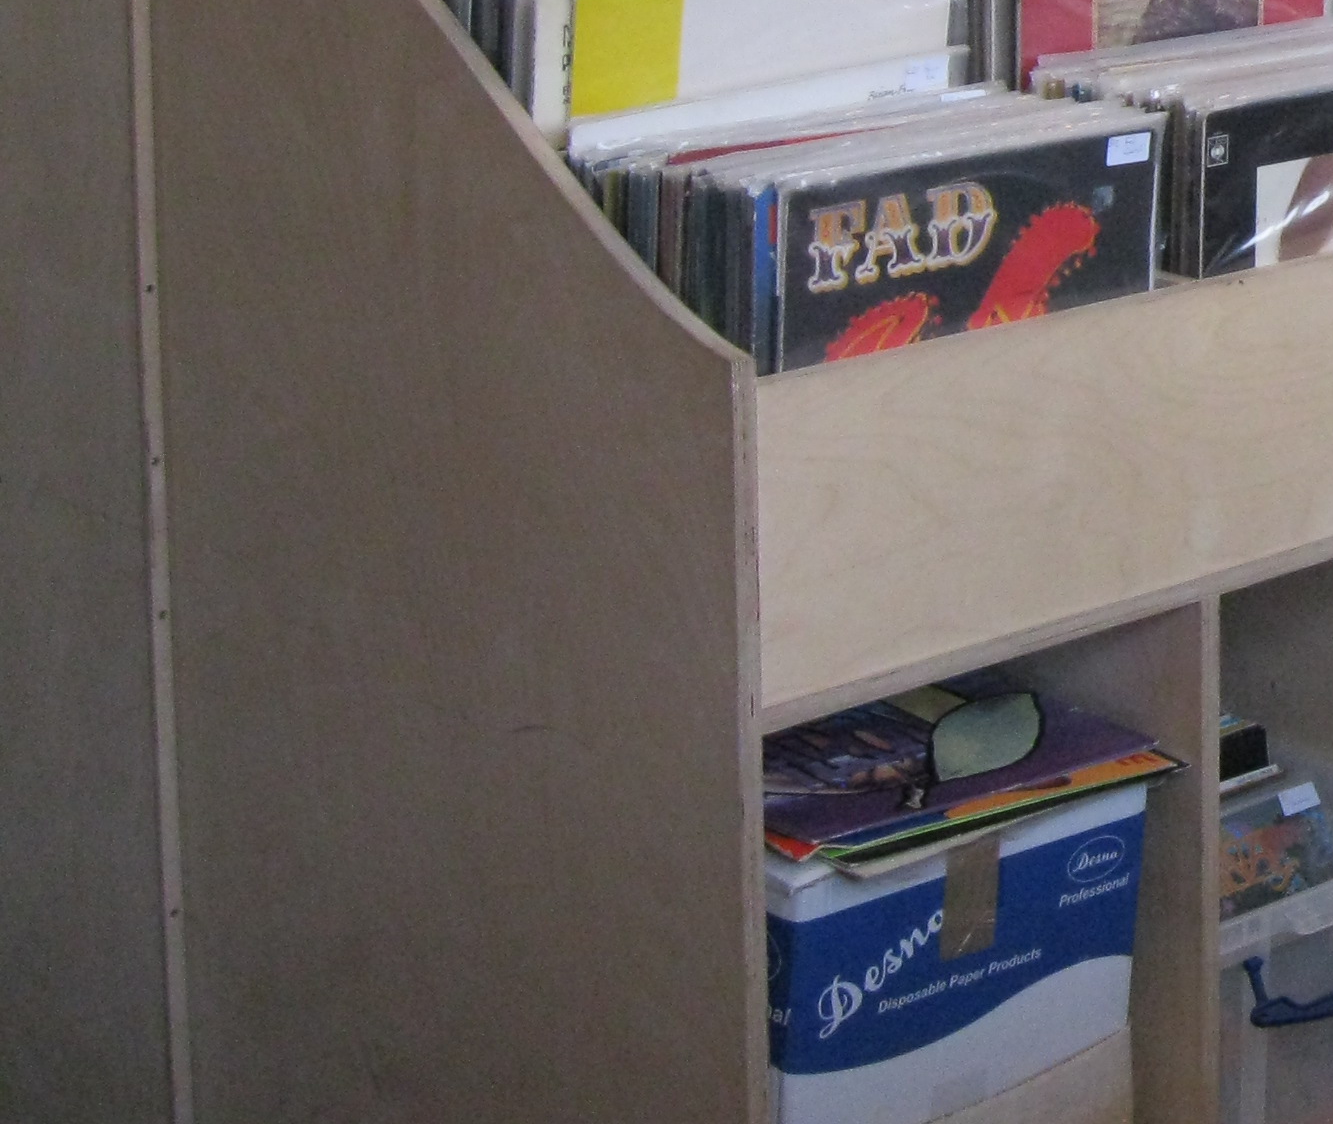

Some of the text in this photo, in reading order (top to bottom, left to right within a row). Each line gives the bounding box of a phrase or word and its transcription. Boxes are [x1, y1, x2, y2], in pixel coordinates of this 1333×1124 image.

[1072, 842, 1121, 874] Desna
[1058, 872, 1131, 908] Professional
[878, 945, 1043, 1014] Disposable Paper Products
